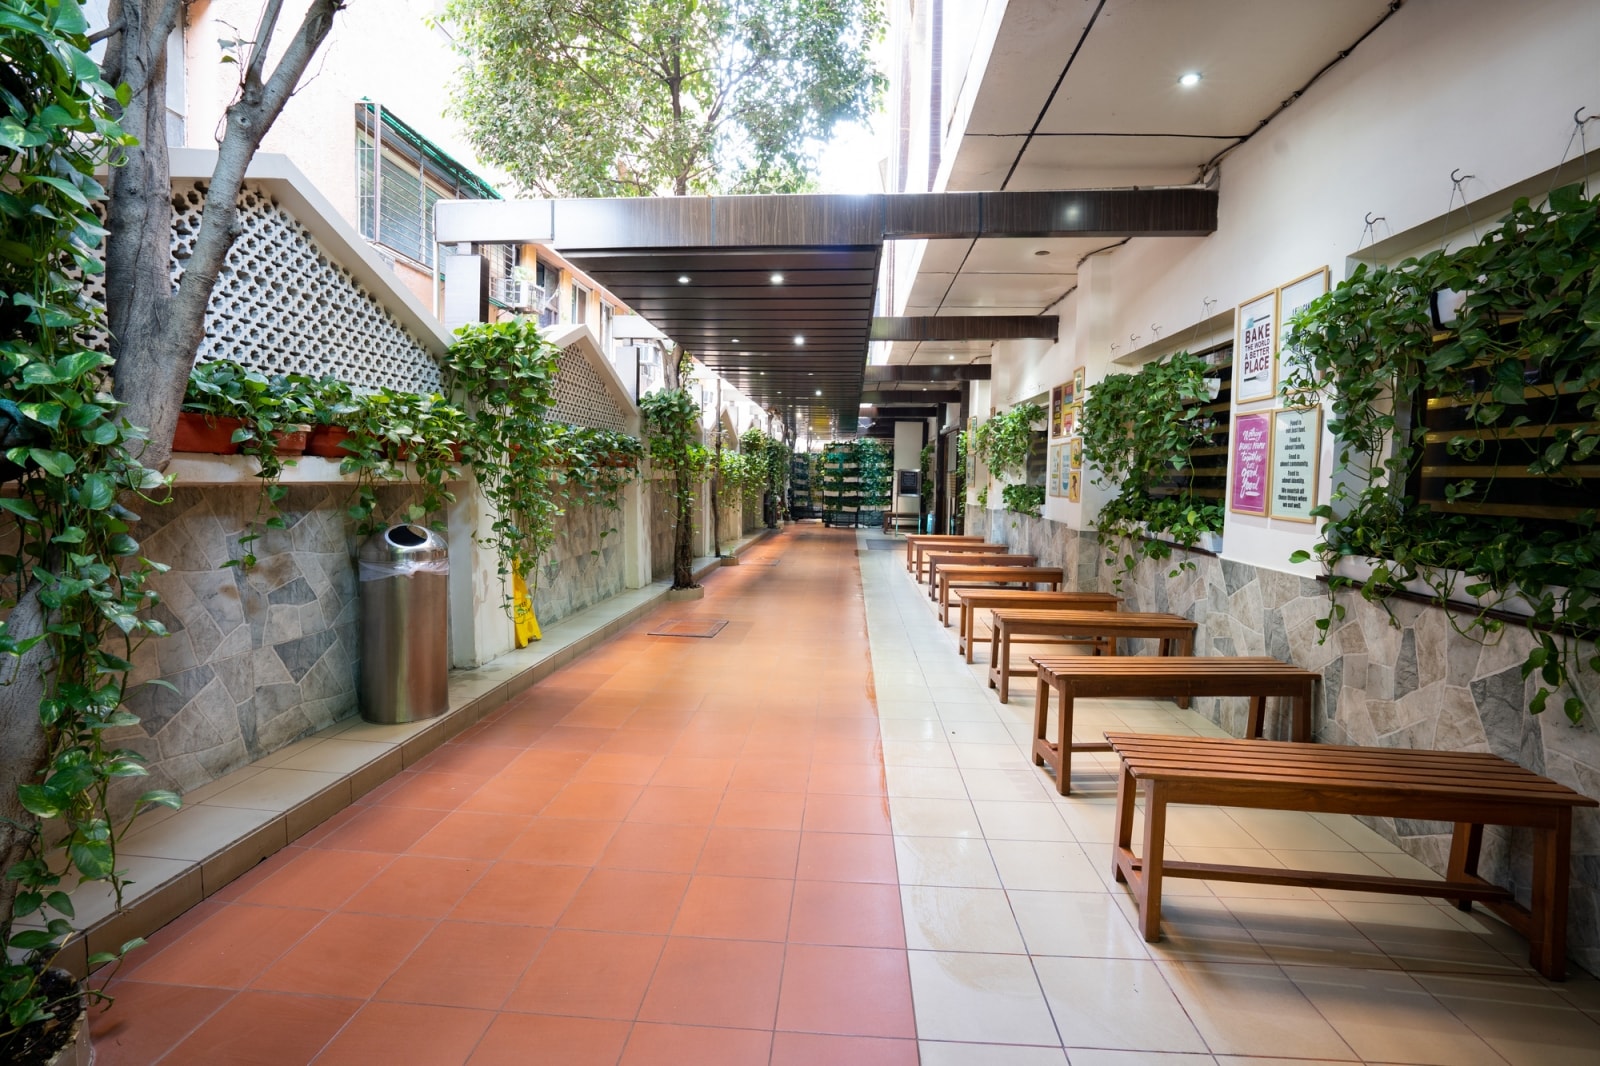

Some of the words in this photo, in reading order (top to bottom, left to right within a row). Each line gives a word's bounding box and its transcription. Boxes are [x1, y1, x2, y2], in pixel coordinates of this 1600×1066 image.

[1245, 323, 1270, 344] BAKE
[1254, 338, 1270, 348] WORLD
[1250, 346, 1269, 359] BETTER
[1245, 355, 1269, 374] PLACE
